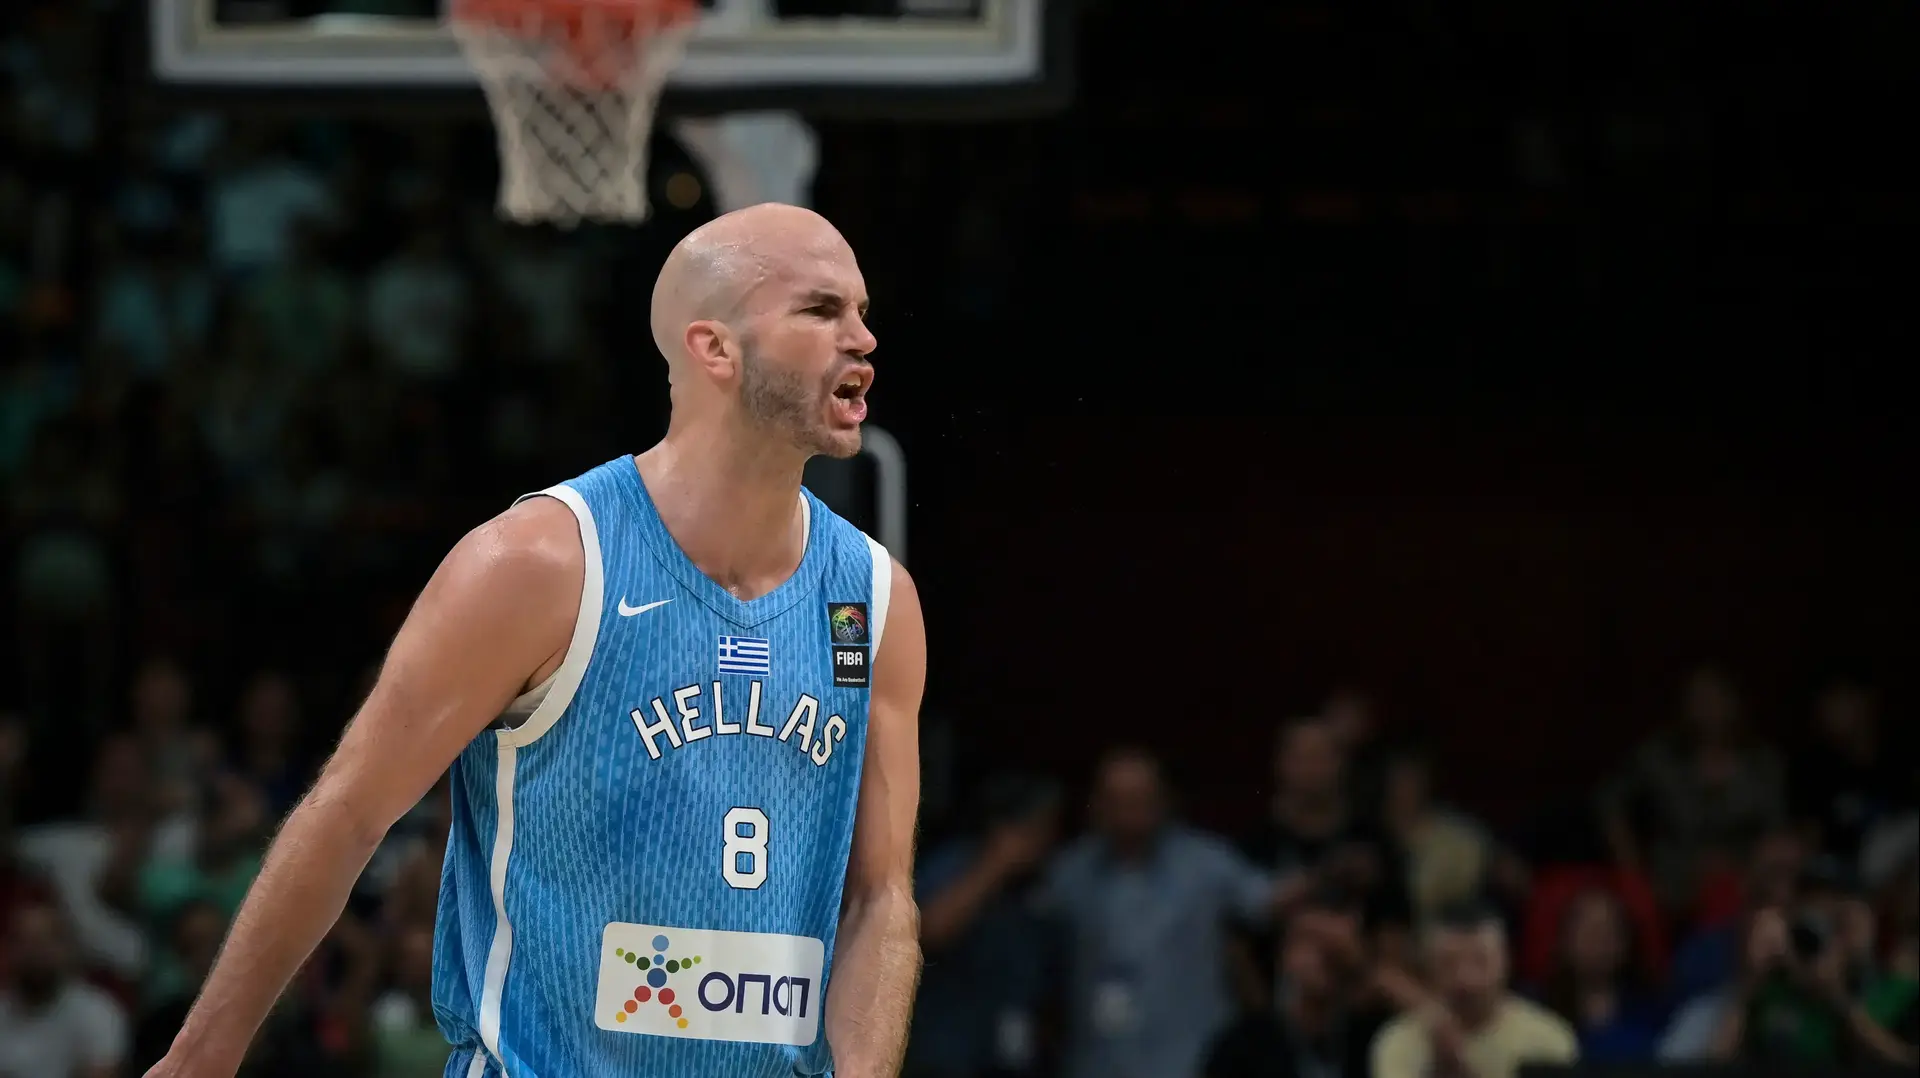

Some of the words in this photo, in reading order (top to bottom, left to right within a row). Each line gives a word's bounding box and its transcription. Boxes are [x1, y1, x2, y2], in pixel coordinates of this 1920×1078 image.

[836, 651, 863, 666] FIBA
[630, 680, 846, 767] HELLAS
[722, 806, 770, 890] 8
